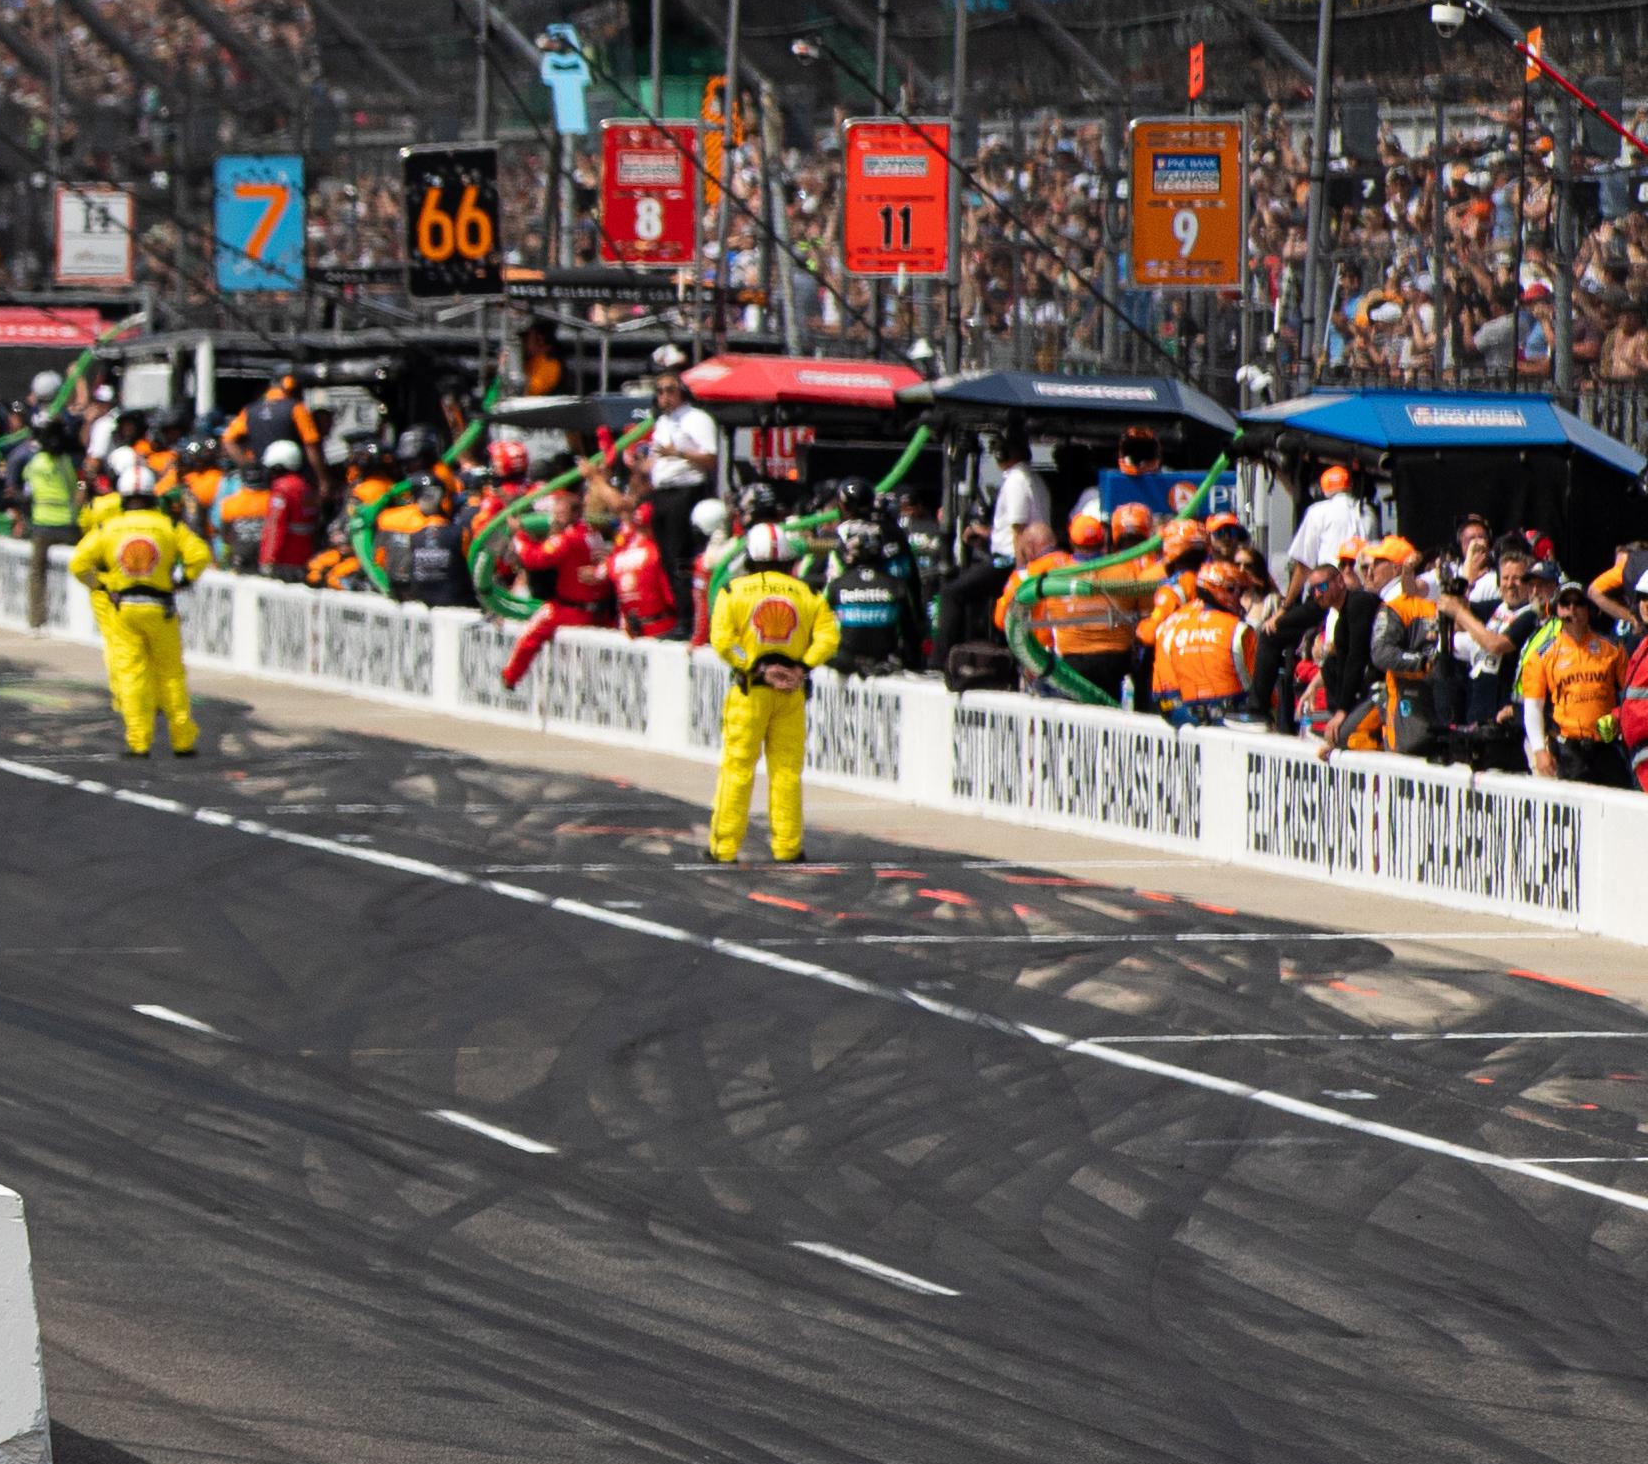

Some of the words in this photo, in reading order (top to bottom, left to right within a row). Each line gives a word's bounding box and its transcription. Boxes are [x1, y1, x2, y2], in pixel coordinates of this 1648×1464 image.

[233, 183, 290, 261] 7
[416, 185, 494, 263] 66
[635, 197, 663, 241] 8
[877, 202, 912, 251] 11
[1171, 208, 1200, 258] 9
[839, 587, 891, 603] Deloitte
[989, 712, 1021, 805] DIXON
[1040, 719, 1064, 813] PNC
[1067, 722, 1099, 822] BANK
[1101, 726, 1153, 832] GANASSI
[1156, 737, 1201, 841] RACING
[1246, 751, 1281, 856] FELIX
[1284, 758, 1366, 875] ROSENQVIST
[1372, 774, 1381, 875] 6
[1387, 775, 1415, 882] NTT
[1417, 780, 1450, 889] DATA
[1454, 787, 1507, 900] ARROW
[1511, 796, 1581, 913] MCLAREN
